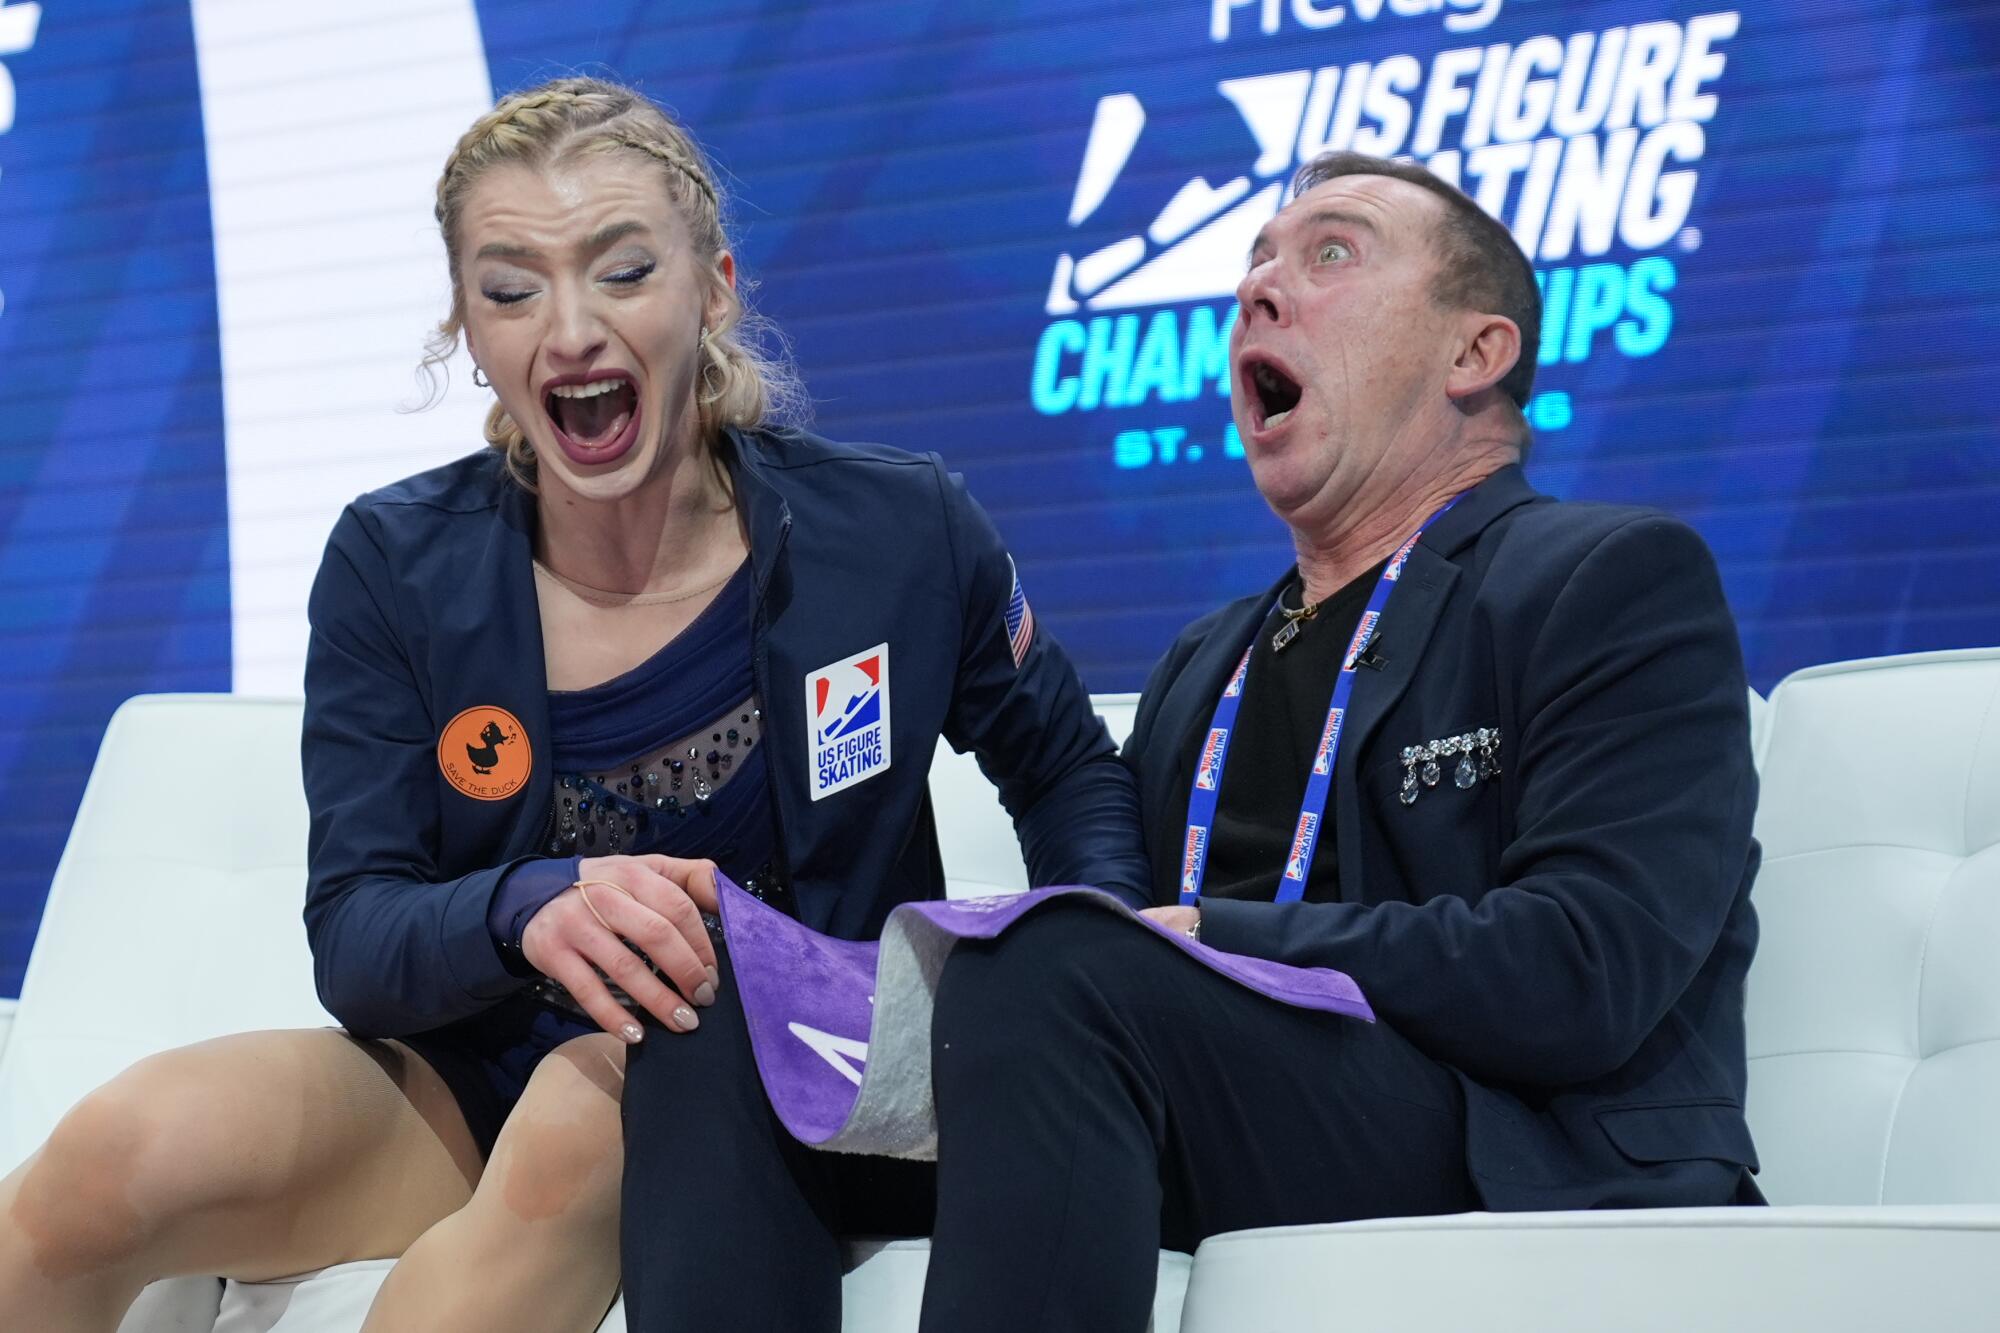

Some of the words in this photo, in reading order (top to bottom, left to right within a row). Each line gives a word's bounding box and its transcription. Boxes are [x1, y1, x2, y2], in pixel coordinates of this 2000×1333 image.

[1297, 54, 1421, 161] US
[1412, 11, 1740, 159] FIGURE
[818, 746, 835, 769] US
[837, 726, 881, 762] FIGURE
[1210, 731, 1227, 768] SKATING
[1326, 711, 1343, 751] SKATING
[446, 762, 466, 787] SAVE
[468, 782, 488, 795] THE
[491, 778, 518, 795] DUCK
[818, 745, 882, 789] SKATING
[1193, 829, 1206, 869] SKATING
[1300, 815, 1317, 857] SKATING
